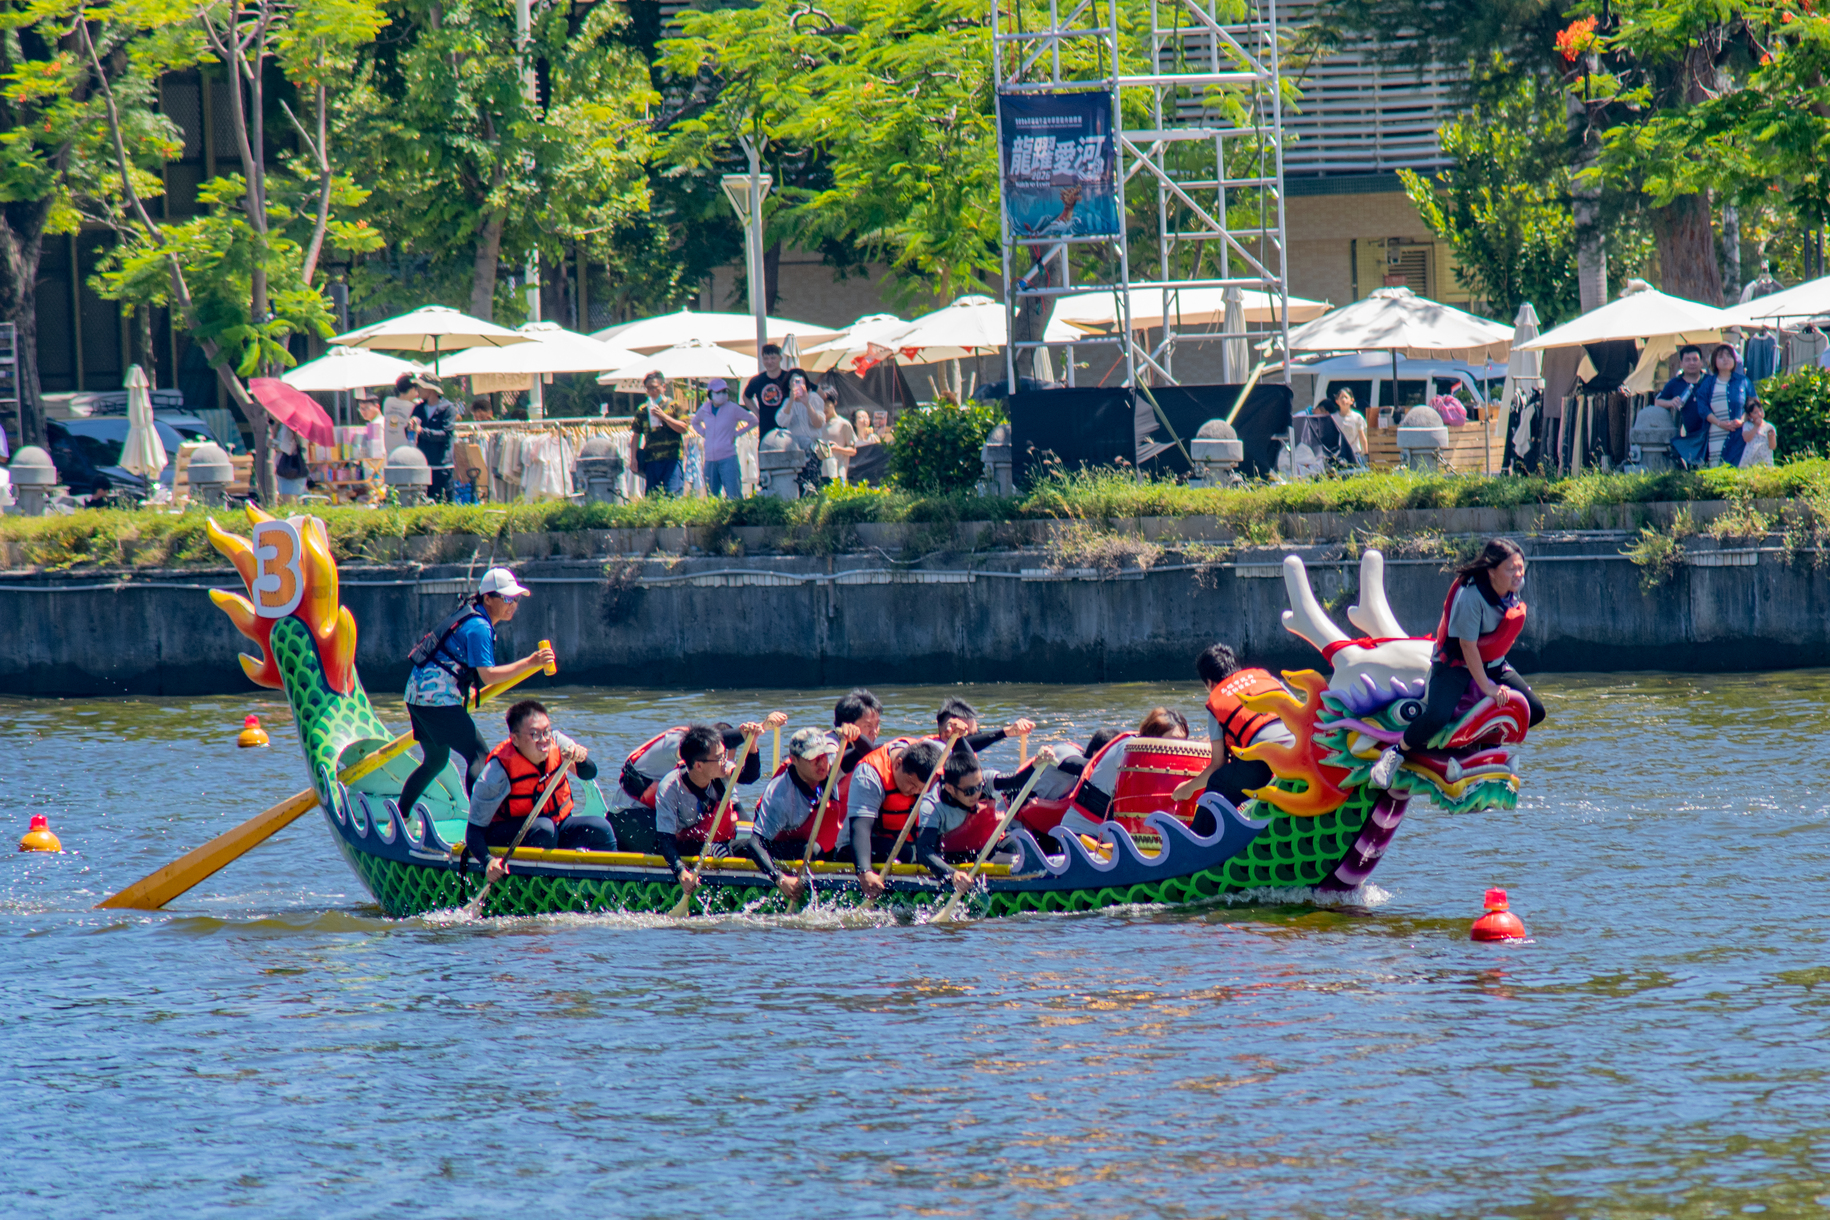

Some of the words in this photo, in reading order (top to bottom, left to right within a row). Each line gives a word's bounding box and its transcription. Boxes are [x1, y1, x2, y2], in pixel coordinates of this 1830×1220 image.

[1010, 135, 1106, 178] 龍躍愛河
[1031, 170, 1051, 181] 2026
[256, 527, 299, 611] 3
